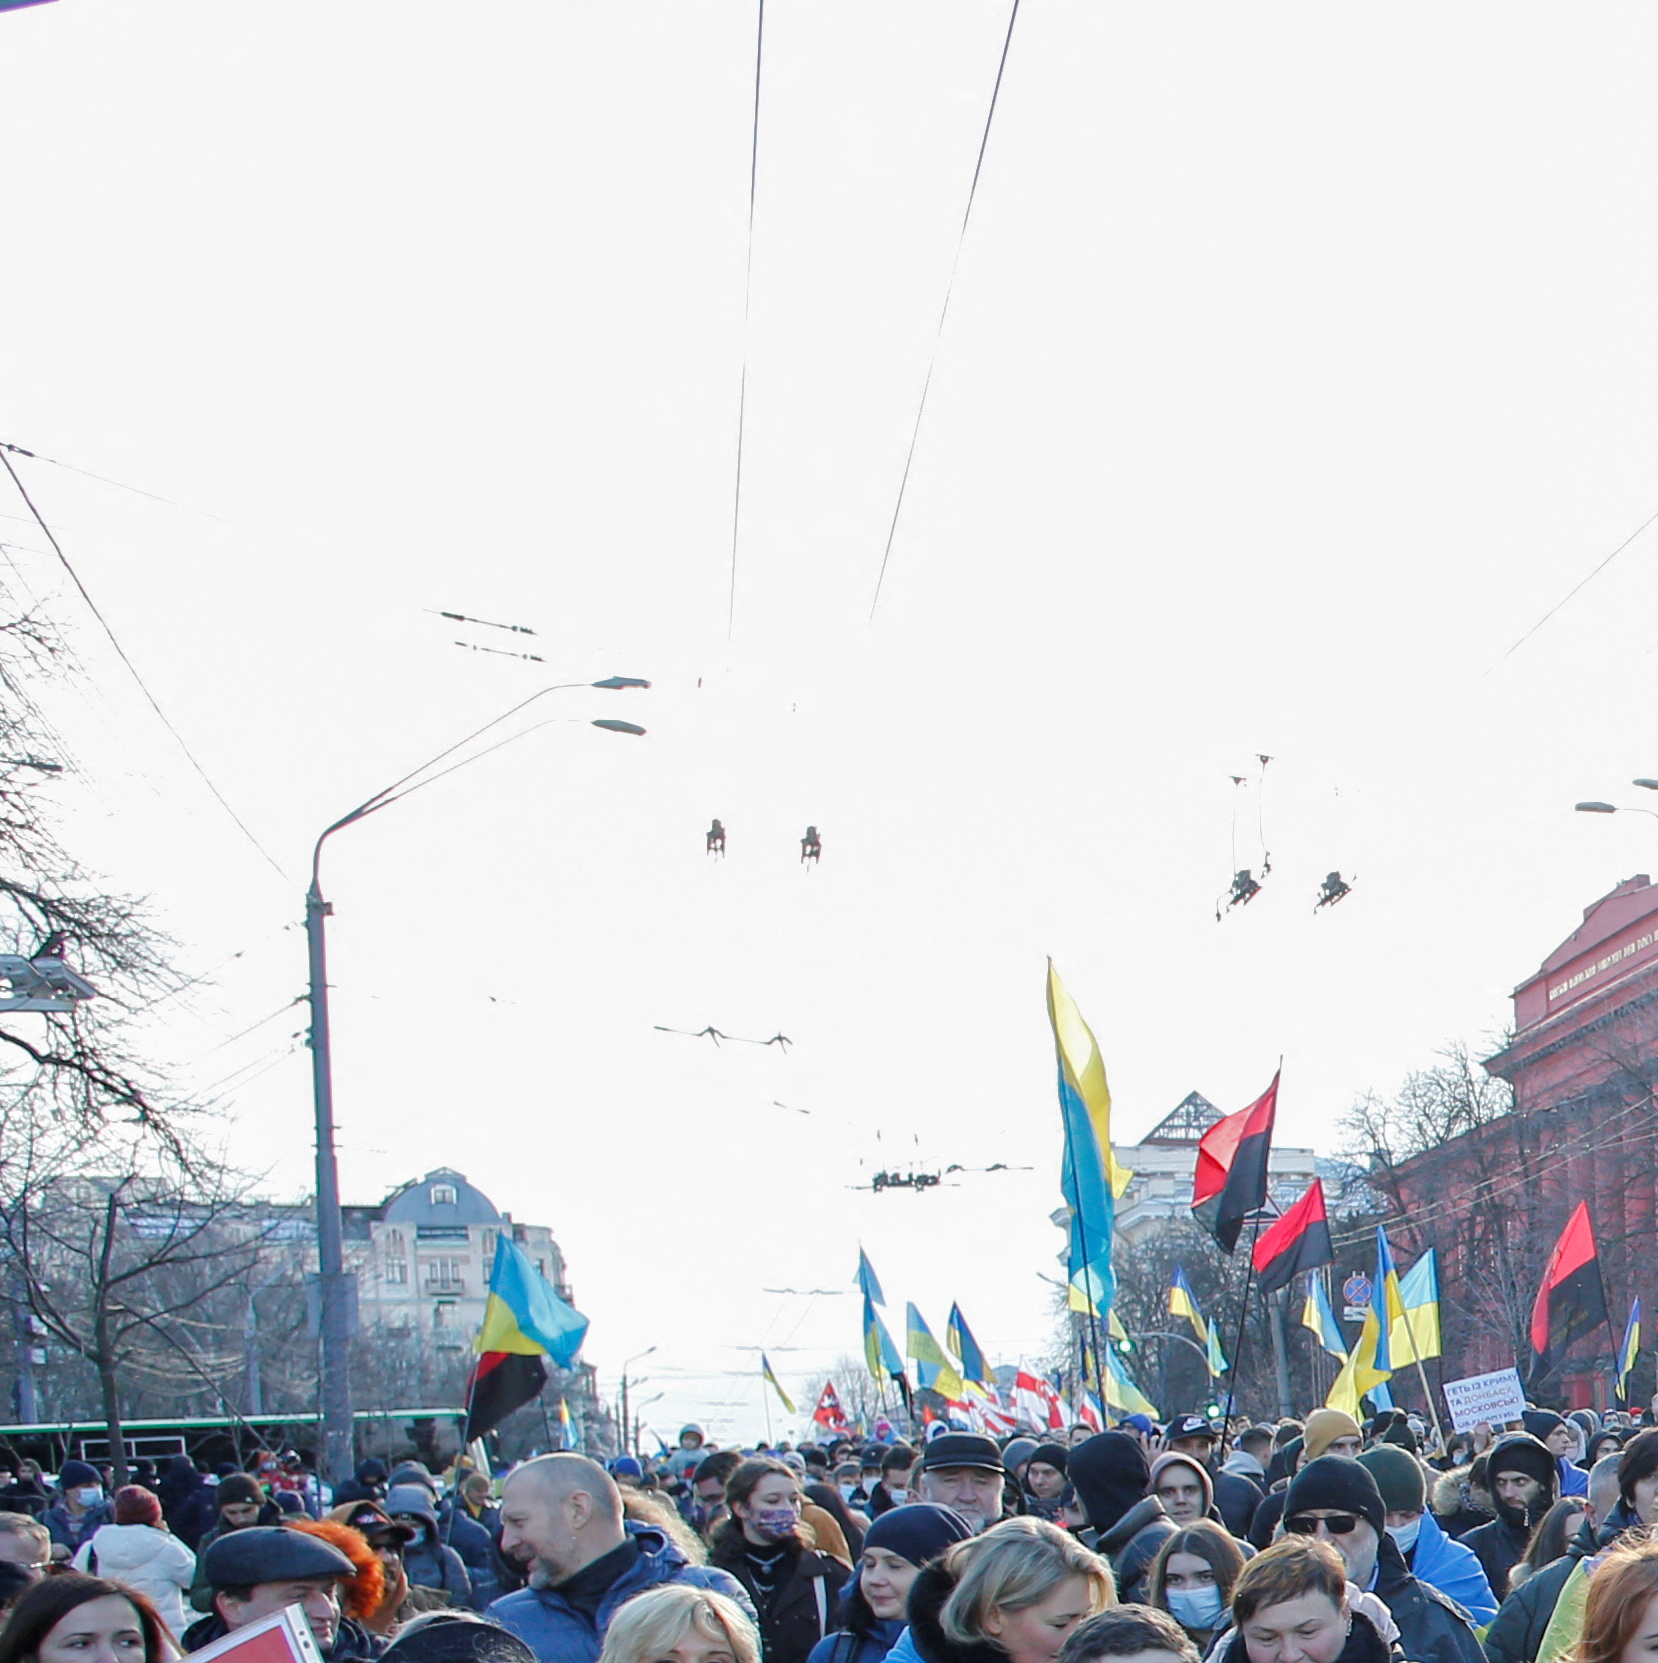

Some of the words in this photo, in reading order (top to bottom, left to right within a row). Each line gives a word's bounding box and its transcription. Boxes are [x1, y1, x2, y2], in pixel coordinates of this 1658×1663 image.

[1446, 1385, 1471, 1397] ГЕТЬ
[1483, 1374, 1518, 1388] КРИМУ
[1450, 1399, 1463, 1407] ТА
[1454, 1396, 1519, 1418] МОСКОВСЬКІ
